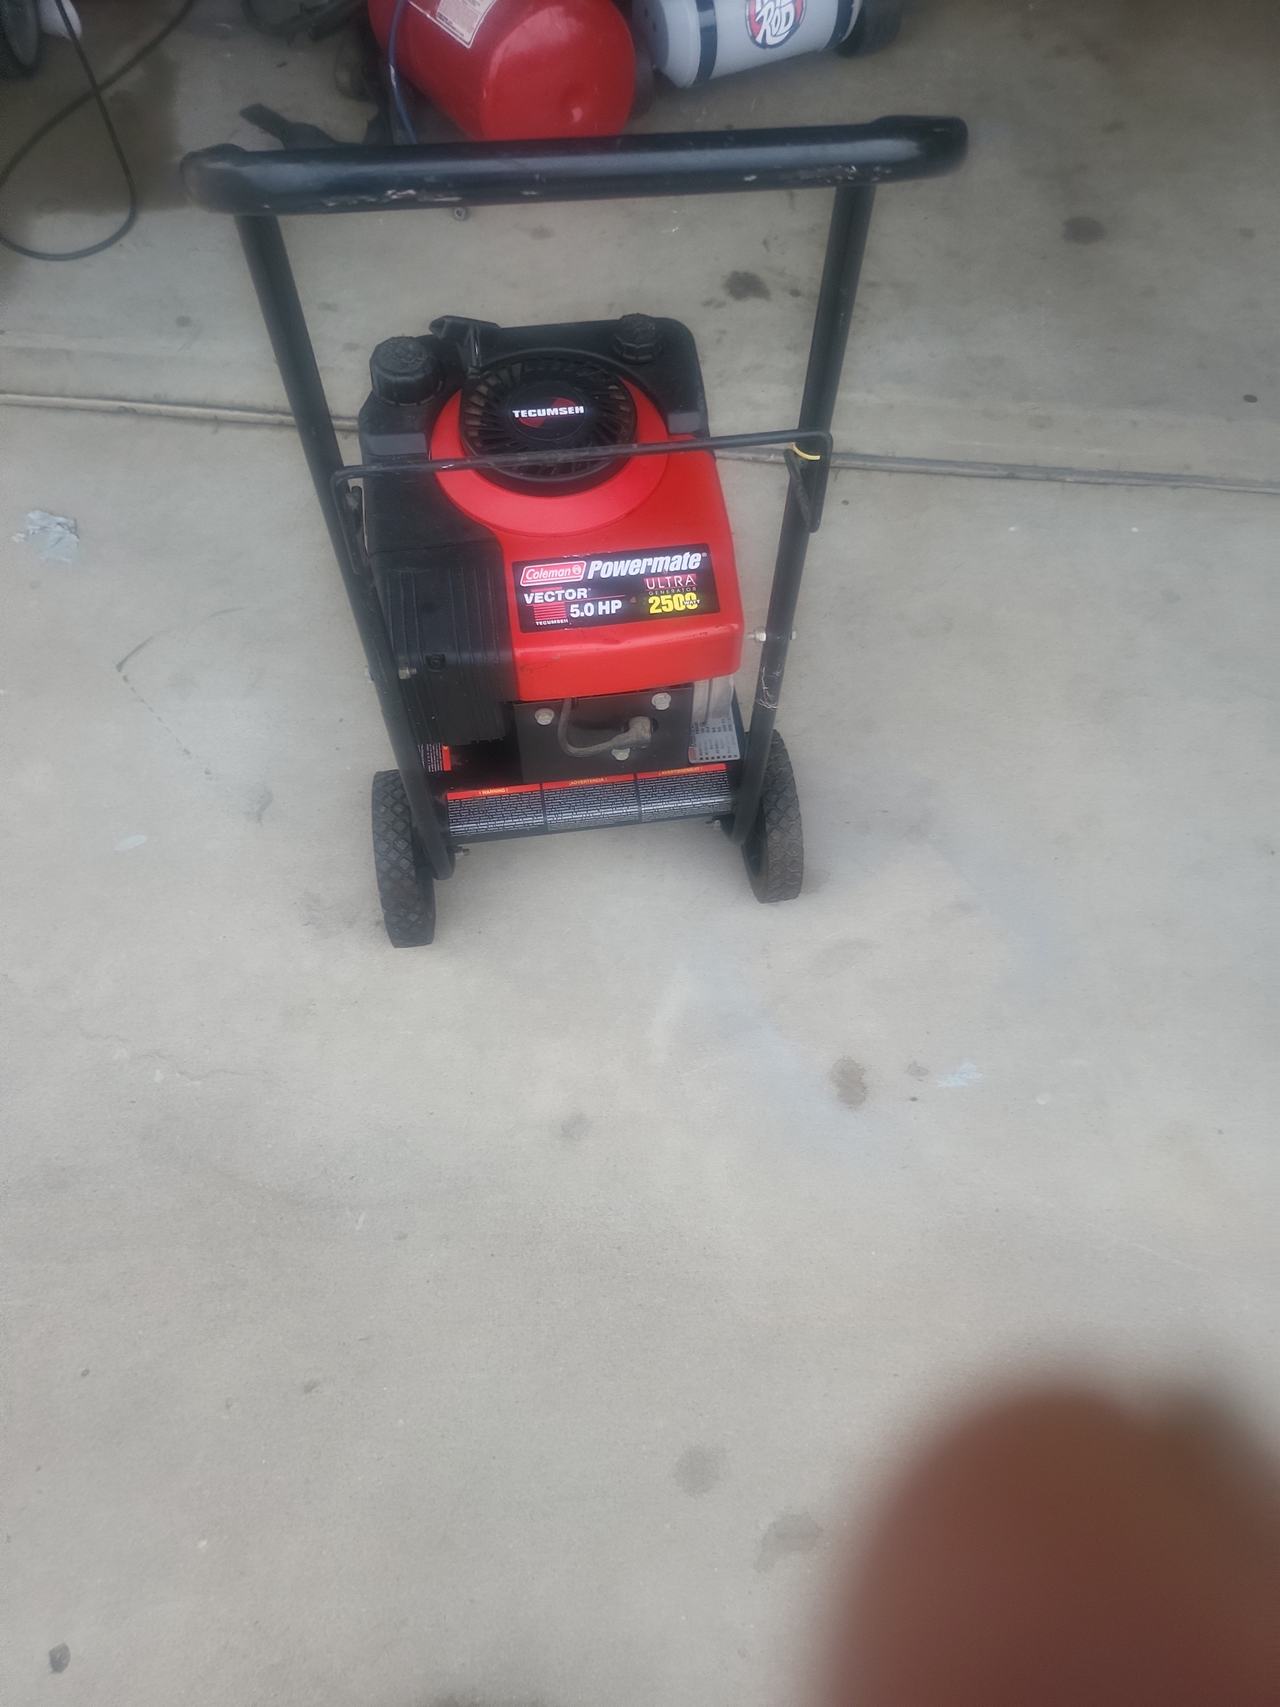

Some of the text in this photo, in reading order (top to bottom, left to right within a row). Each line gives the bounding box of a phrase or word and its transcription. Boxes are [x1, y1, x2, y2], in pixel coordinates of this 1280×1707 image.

[755, 1, 795, 45] ROD
[512, 405, 585, 418] TECUMSEH
[525, 552, 702, 580] Coleman Powermate
[646, 575, 697, 590] ULTRA
[524, 588, 588, 604] VECTOR
[648, 587, 697, 596] GENERATOR
[570, 600, 622, 618] 5.0 HP
[648, 592, 698, 614] 2500
